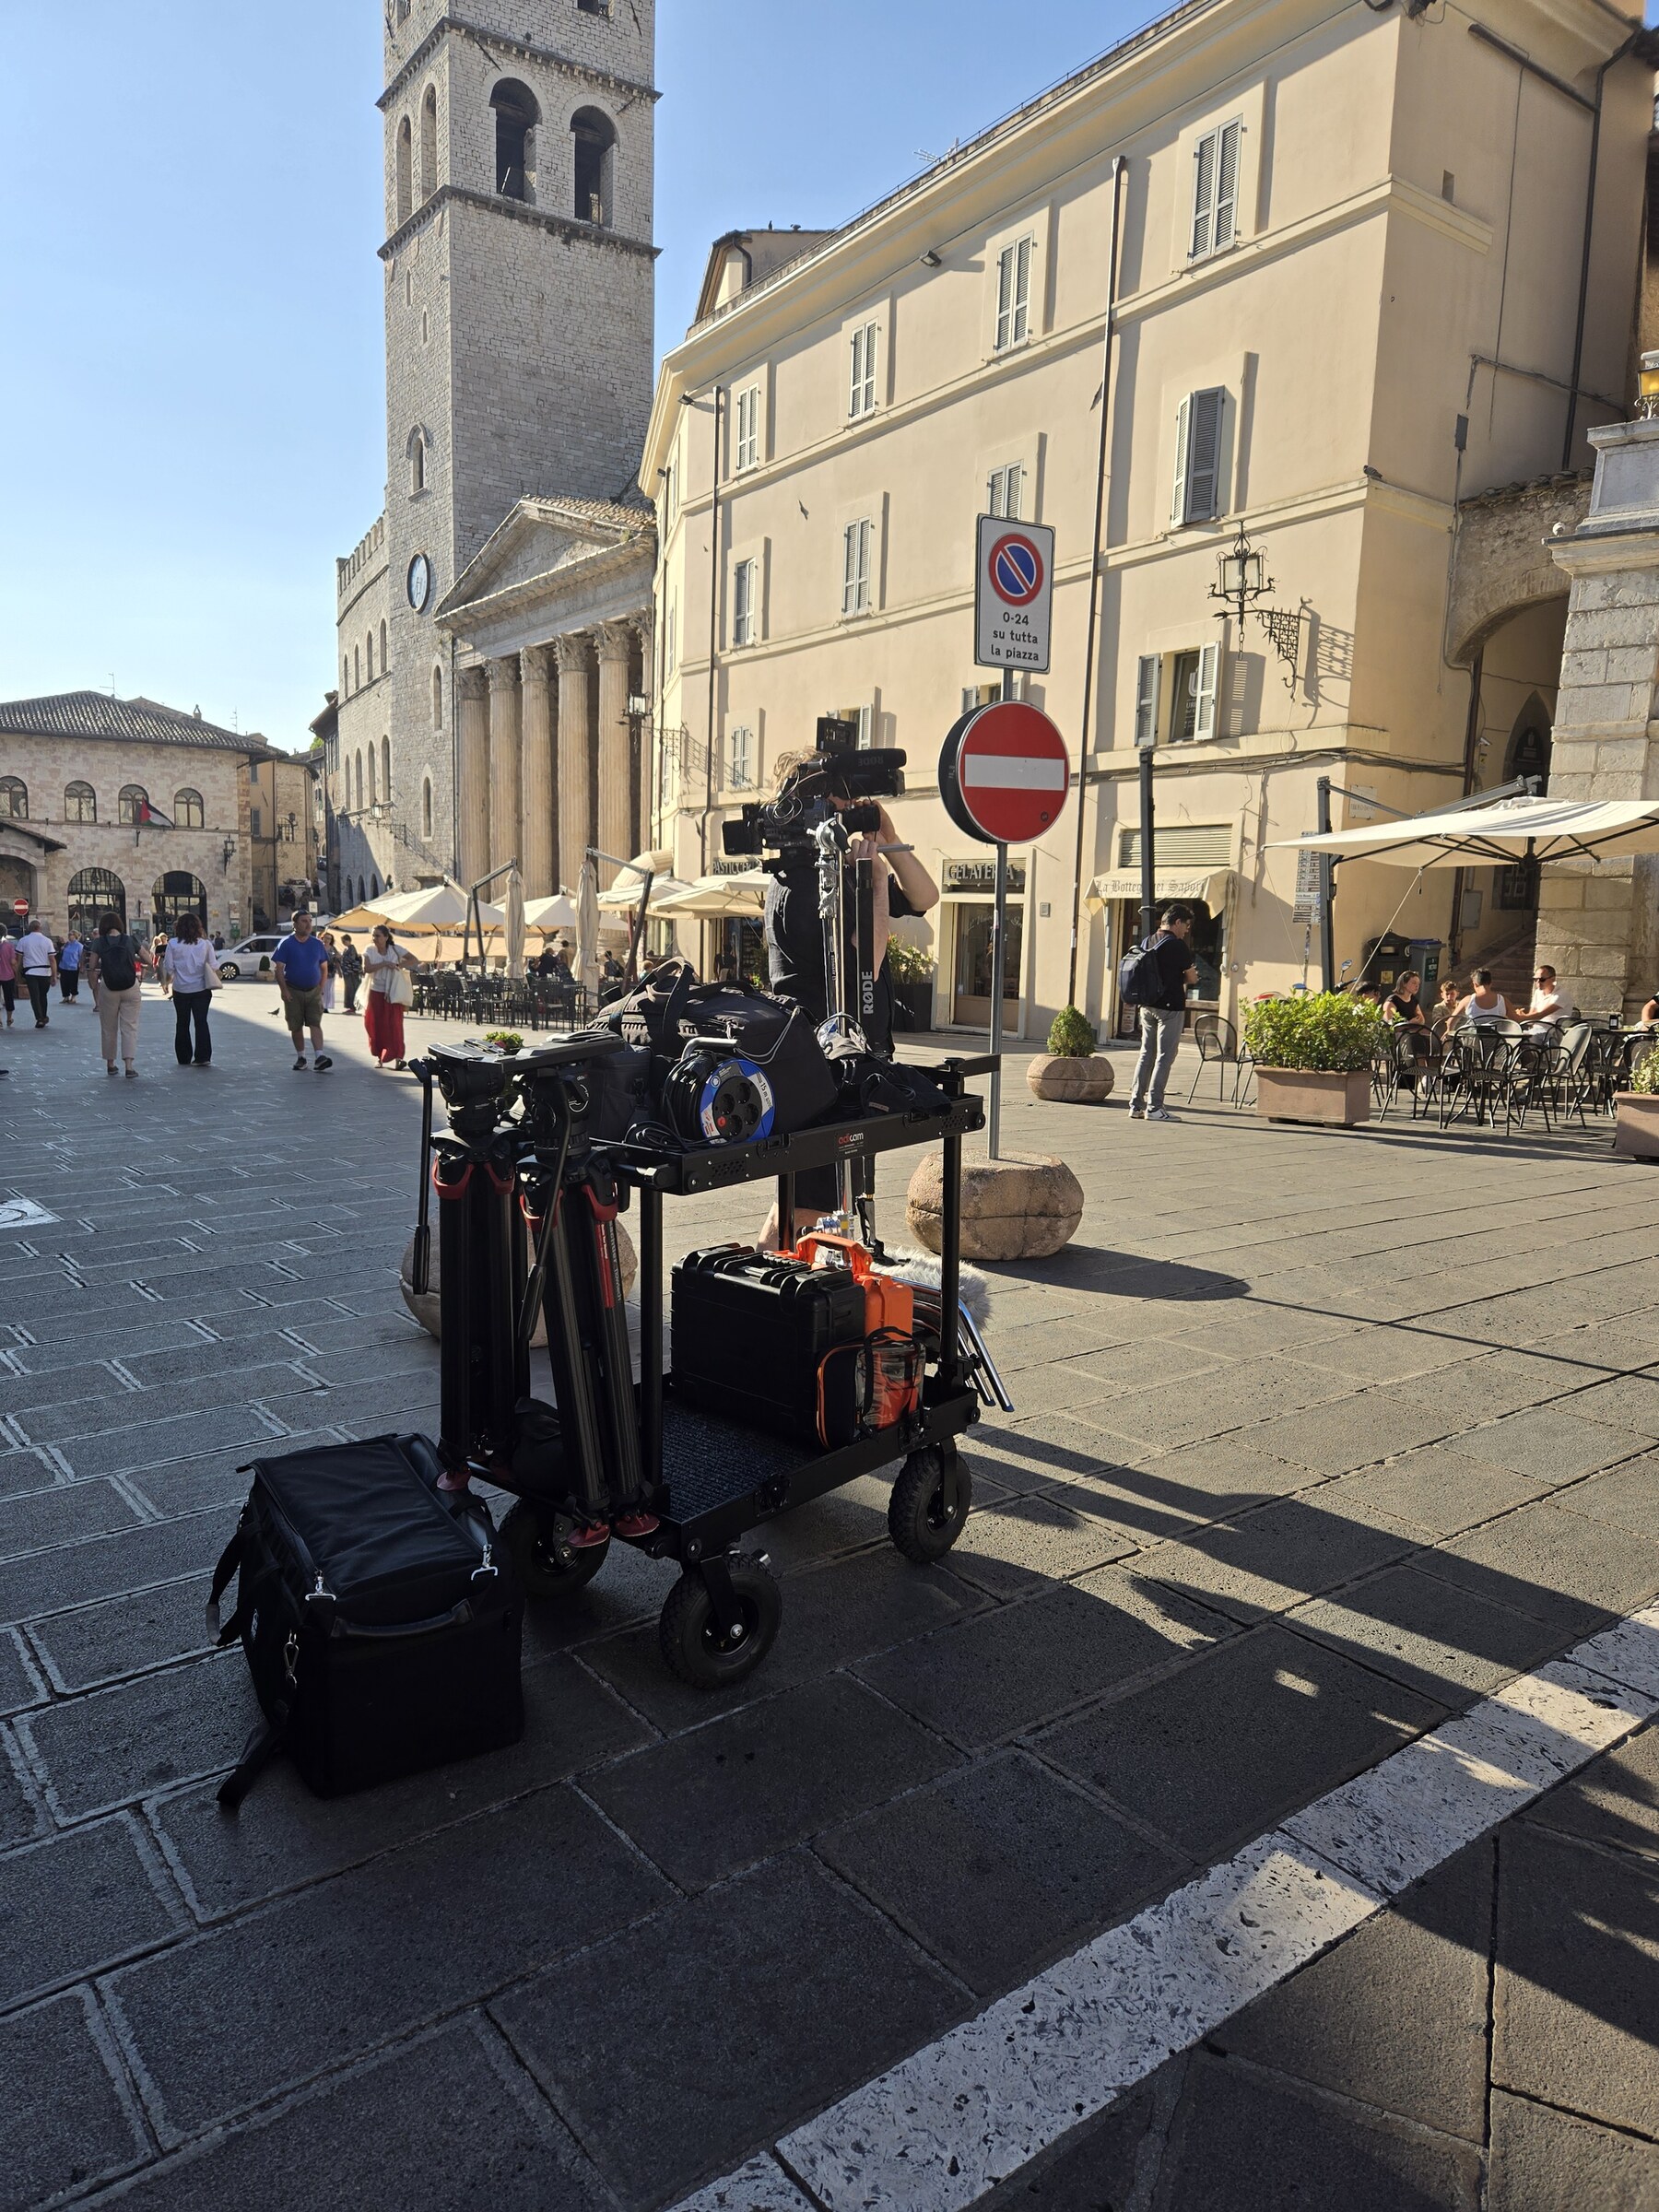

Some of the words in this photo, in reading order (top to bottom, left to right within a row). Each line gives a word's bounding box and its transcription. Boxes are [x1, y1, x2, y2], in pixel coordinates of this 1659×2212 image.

[1003, 611, 1030, 626] 0-24
[993, 629, 1005, 640] su
[1010, 629, 1039, 644] tutta
[991, 644, 1001, 656] la
[1006, 647, 1040, 661] piazza
[1112, 879, 1143, 895] Botteg
[861, 971, 874, 1015] RØDE
[760, 1082, 767, 1091] 15
